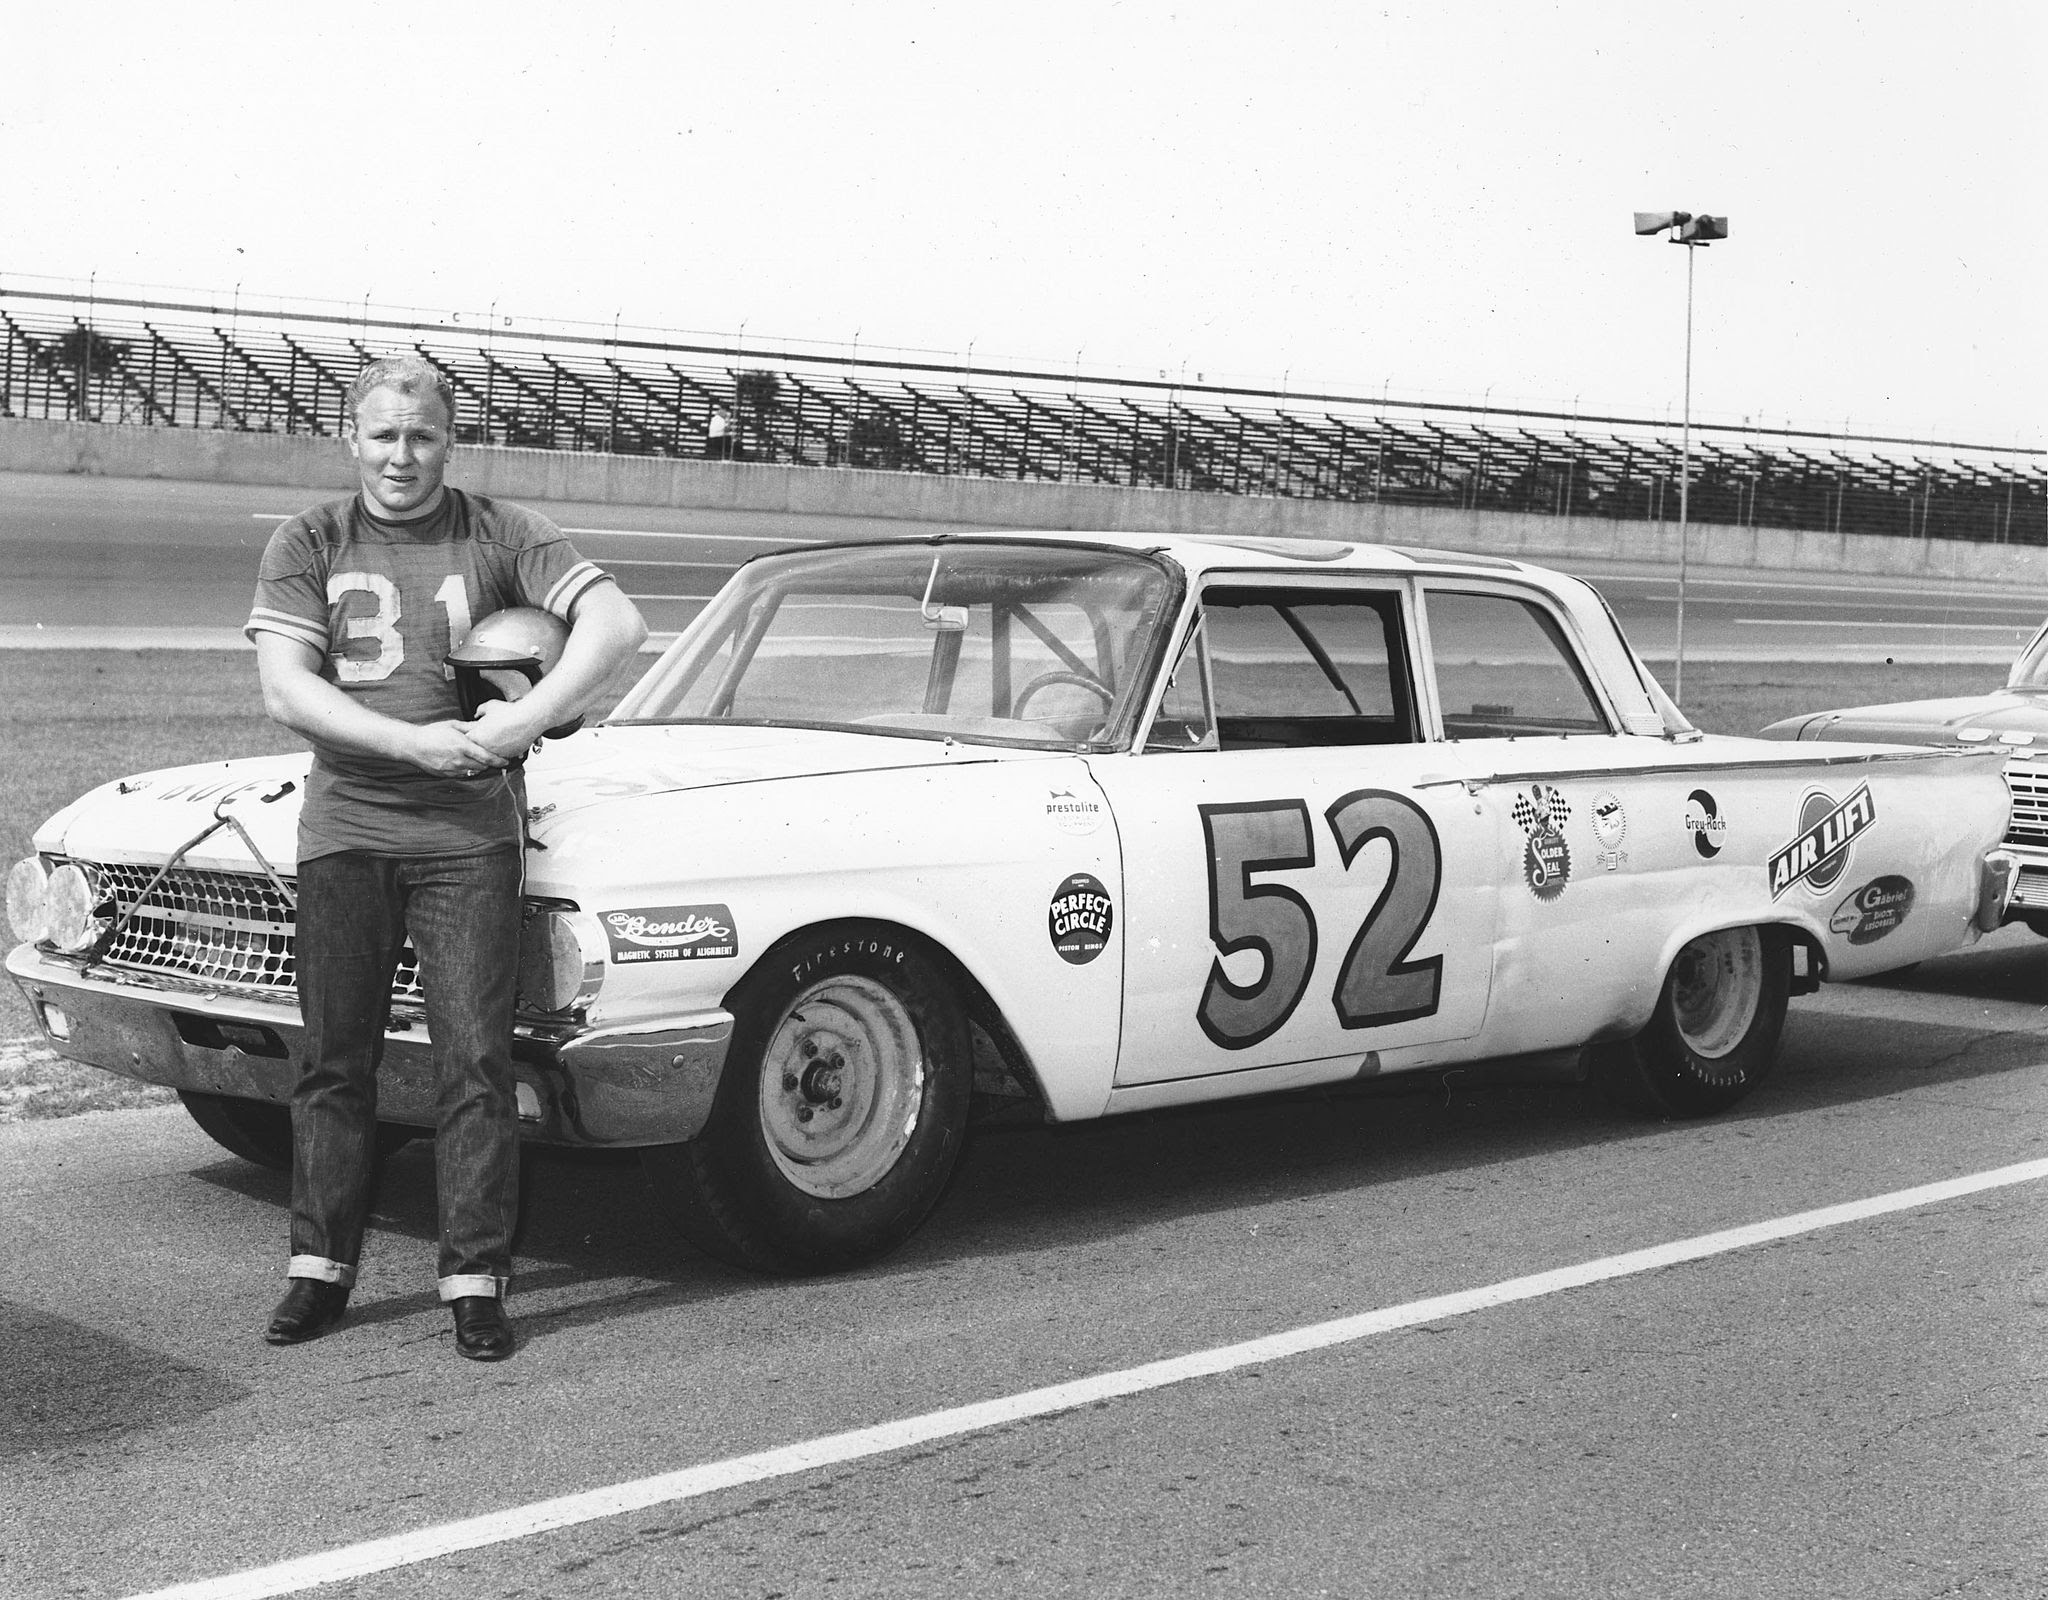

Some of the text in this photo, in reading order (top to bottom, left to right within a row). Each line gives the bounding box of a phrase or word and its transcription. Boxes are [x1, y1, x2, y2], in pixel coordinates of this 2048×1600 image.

[327, 571, 472, 683] 31
[1046, 801, 1099, 815] prestolite
[1773, 789, 1871, 893] AIR LIFT
[1050, 893, 1111, 920] PERFECT
[1197, 788, 1443, 1051] 52
[615, 914, 724, 938] Bender
[1055, 911, 1106, 935] CIRCLE
[617, 946, 733, 961] MAGNETIC SYSTEM OF ALIGNMENT
[792, 940, 904, 981] Firestone
